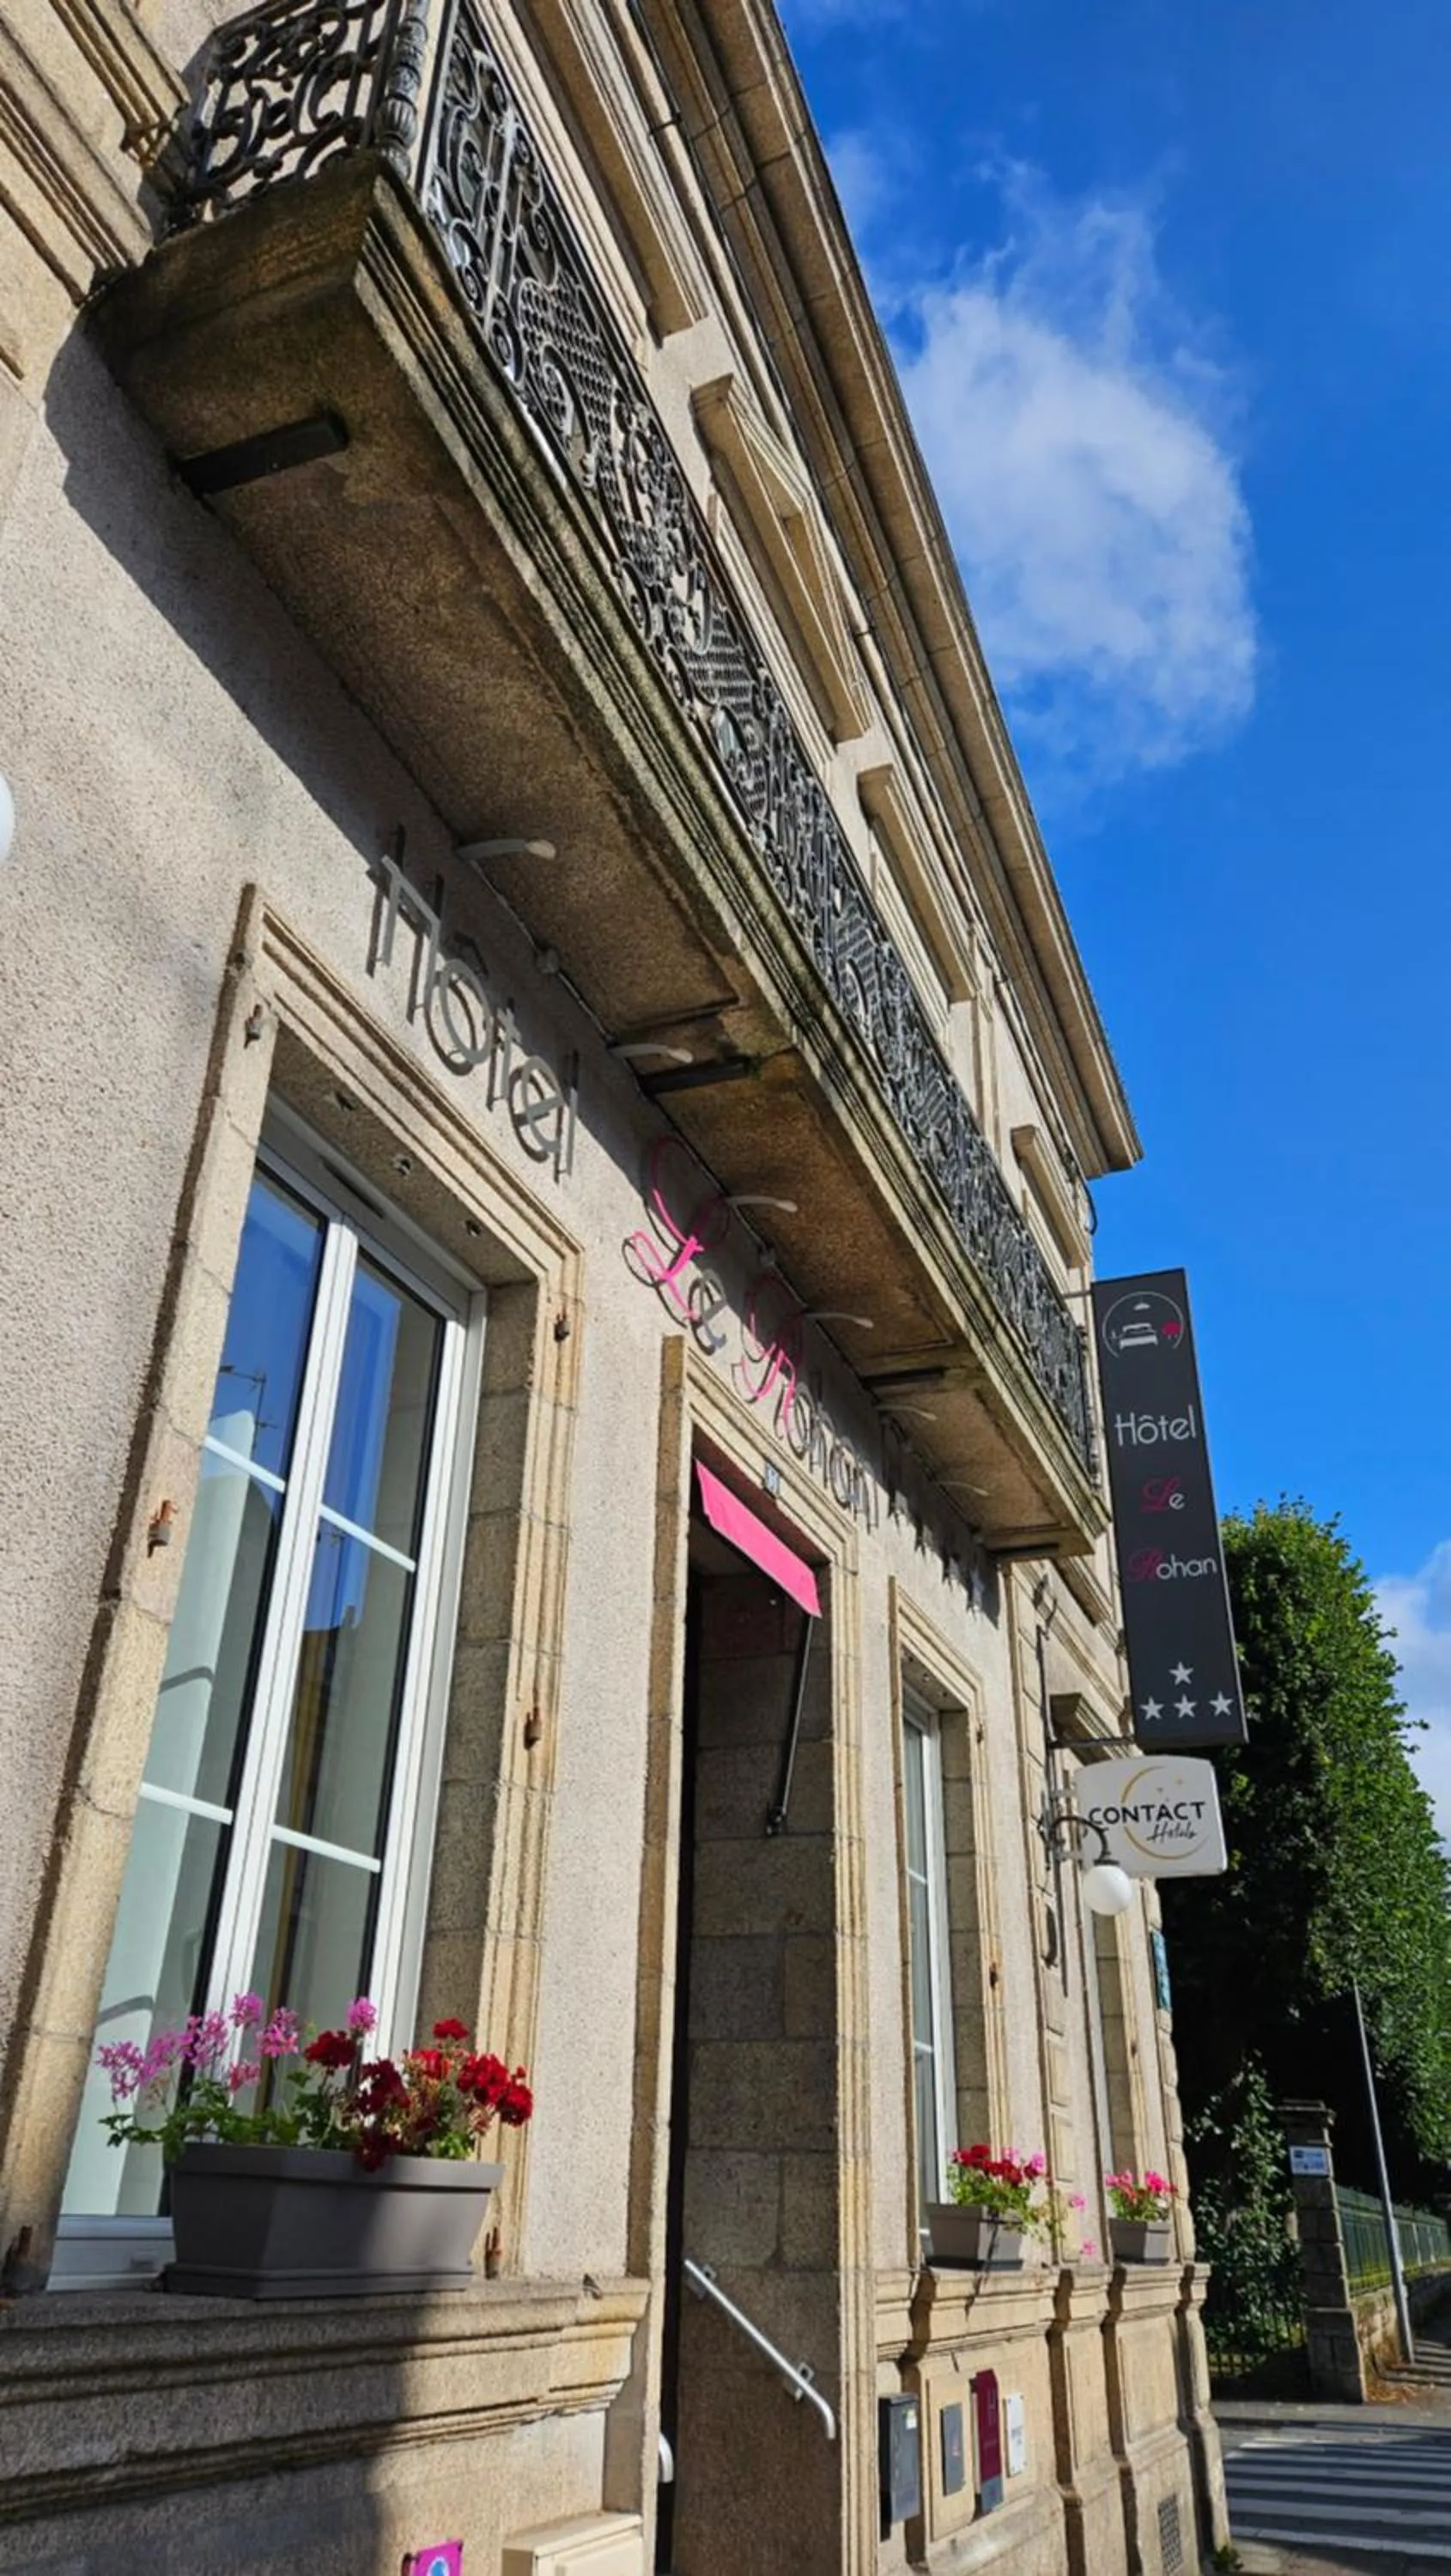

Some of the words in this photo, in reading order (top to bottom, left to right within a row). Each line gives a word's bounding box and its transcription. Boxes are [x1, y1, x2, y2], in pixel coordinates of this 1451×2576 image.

[629, 1136, 731, 1353] Le
[1114, 1404, 1196, 1446] Hôtel
[1140, 1475, 1185, 1514] Le
[1128, 1547, 1217, 1581] Rohan
[1089, 1801, 1205, 1825] CONTACT
